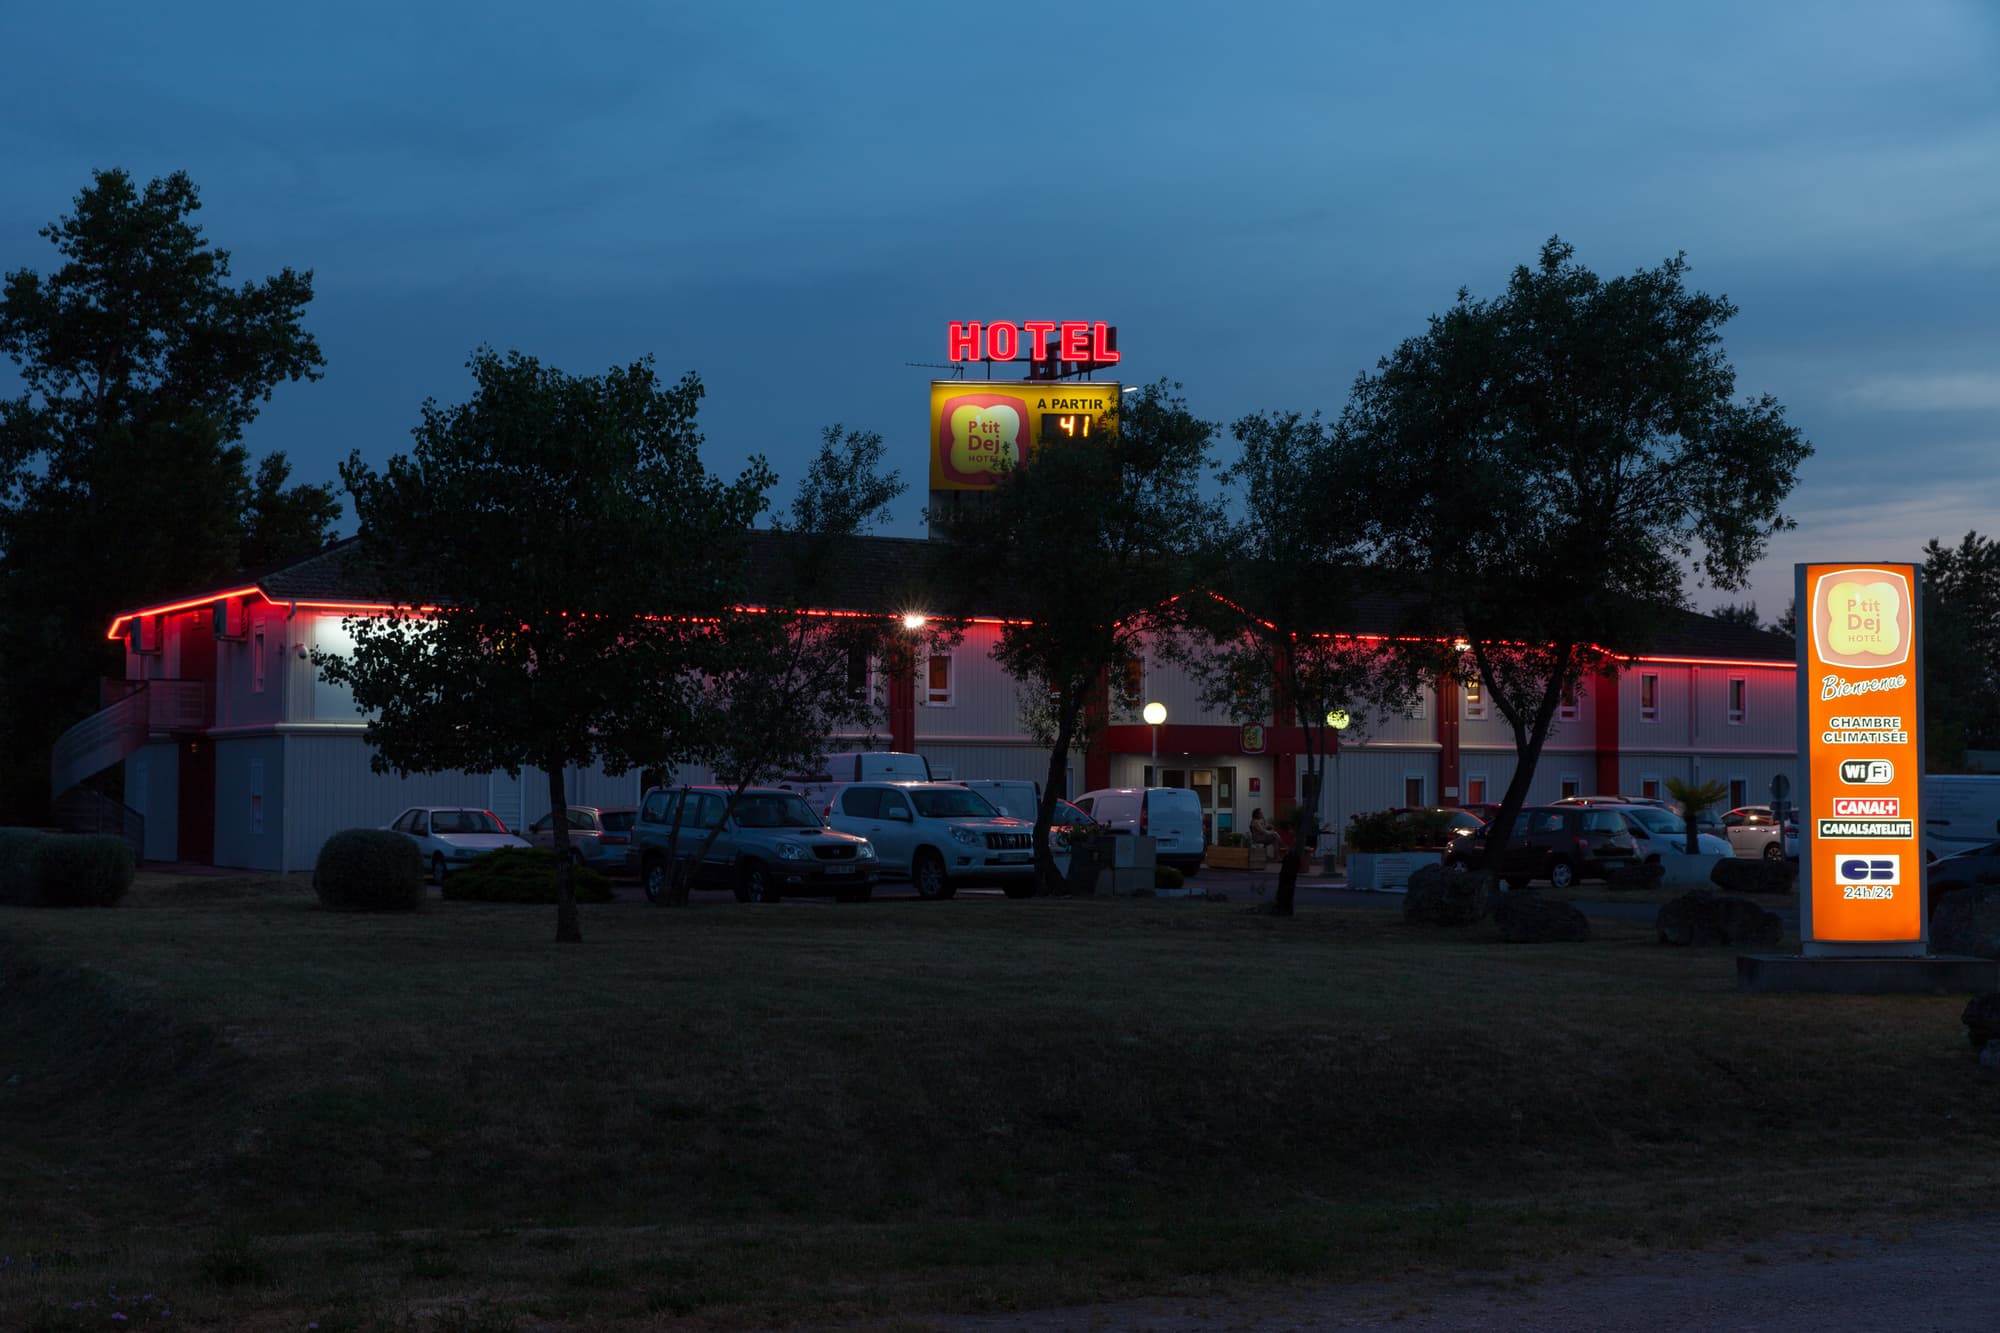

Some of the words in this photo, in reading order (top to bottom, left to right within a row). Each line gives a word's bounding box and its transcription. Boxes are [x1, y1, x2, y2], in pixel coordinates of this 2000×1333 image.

[949, 321, 1120, 362] HOTEL
[1037, 399, 1047, 409] A
[1051, 399, 1103, 409] PARTIR
[1060, 415, 1090, 438] 41
[968, 434, 1000, 455] Dej
[1847, 613, 1881, 634] Dej
[1848, 635, 1882, 643] HOTEL
[1821, 675, 1905, 700] Bienvenue
[1830, 717, 1901, 728] CHAMBRE
[1823, 730, 1907, 742] CLIMATISÉE
[1836, 801, 1896, 815] CANAL+
[1822, 823, 1910, 835] CANALSATELLITE
[1845, 886, 1891, 898] 24h/24
